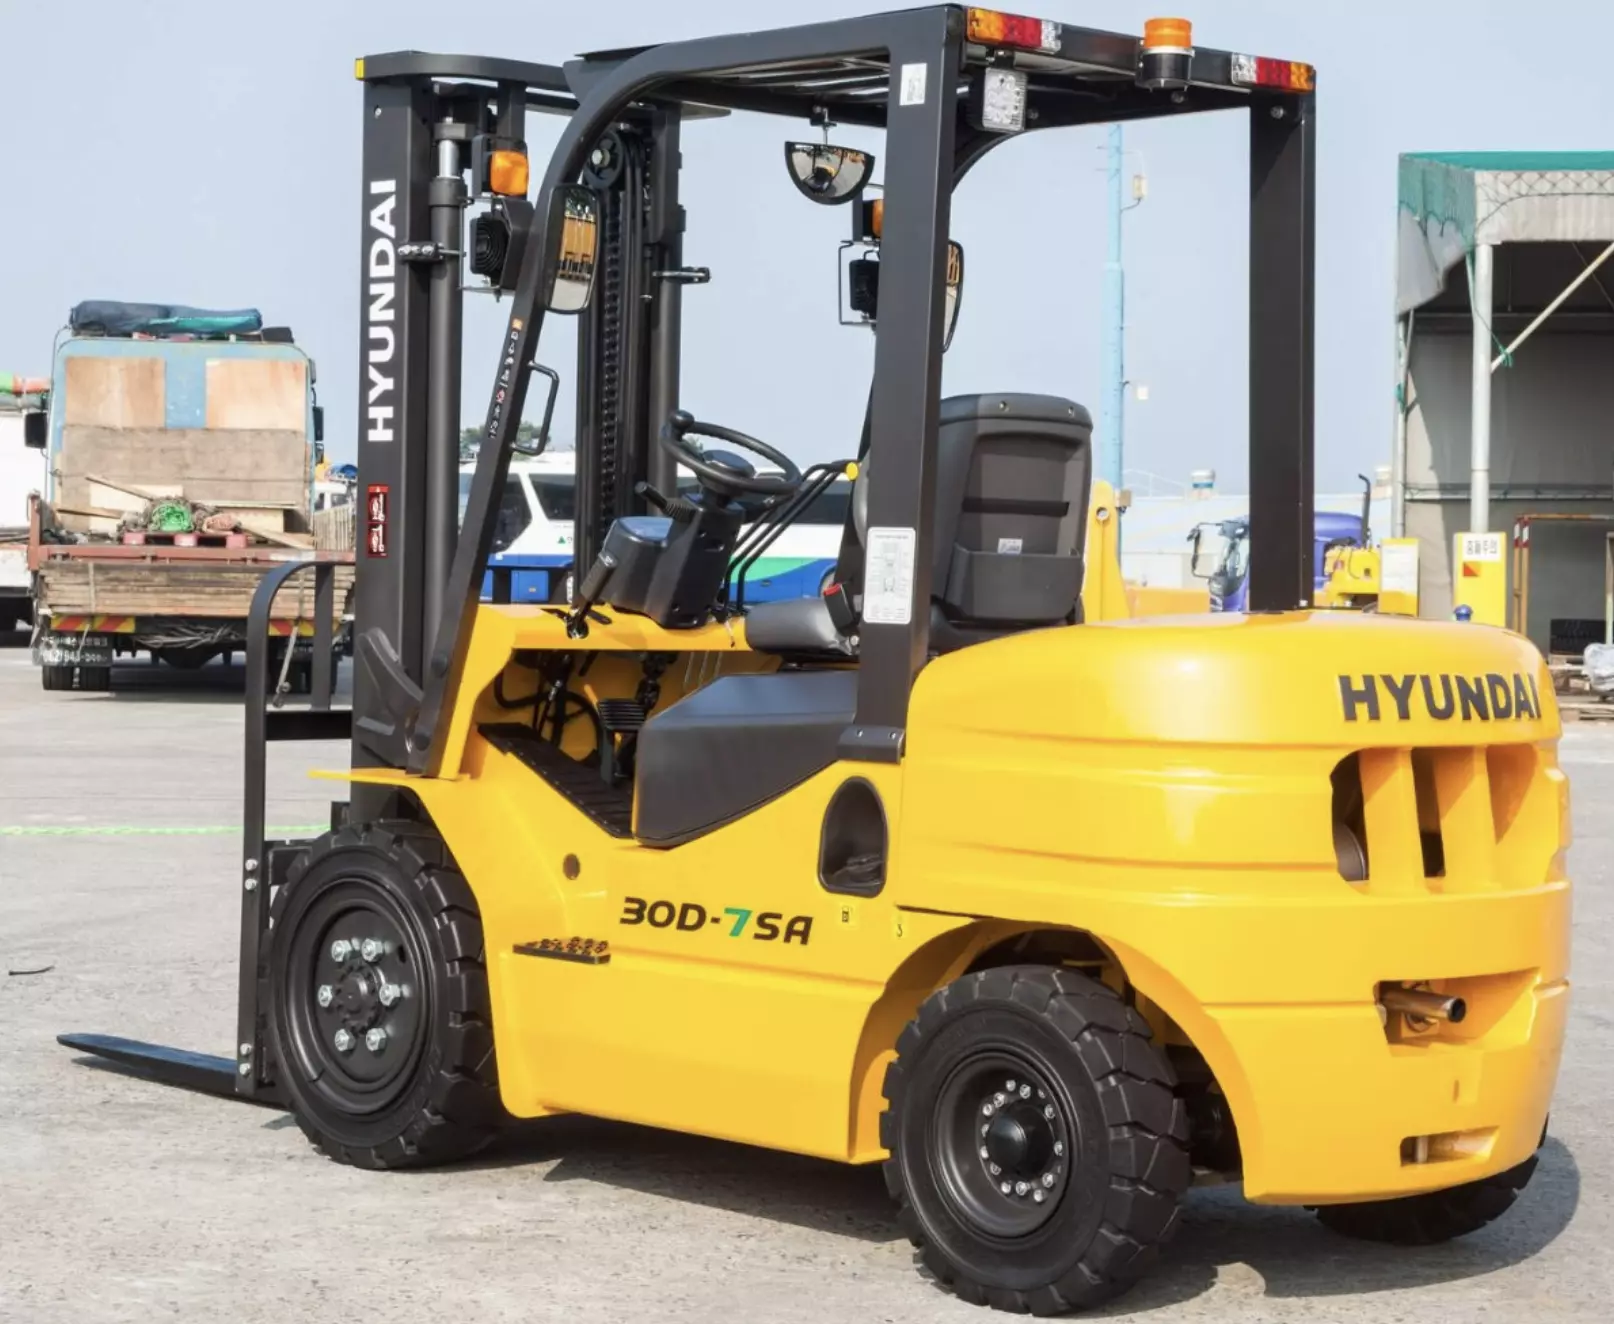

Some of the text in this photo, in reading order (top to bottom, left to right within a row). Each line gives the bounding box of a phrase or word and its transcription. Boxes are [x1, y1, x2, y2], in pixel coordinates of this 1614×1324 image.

[367, 178, 397, 442] HYUNDAI
[1338, 673, 1542, 721] HYUNDAI
[619, 896, 814, 946] 30D-7SA
